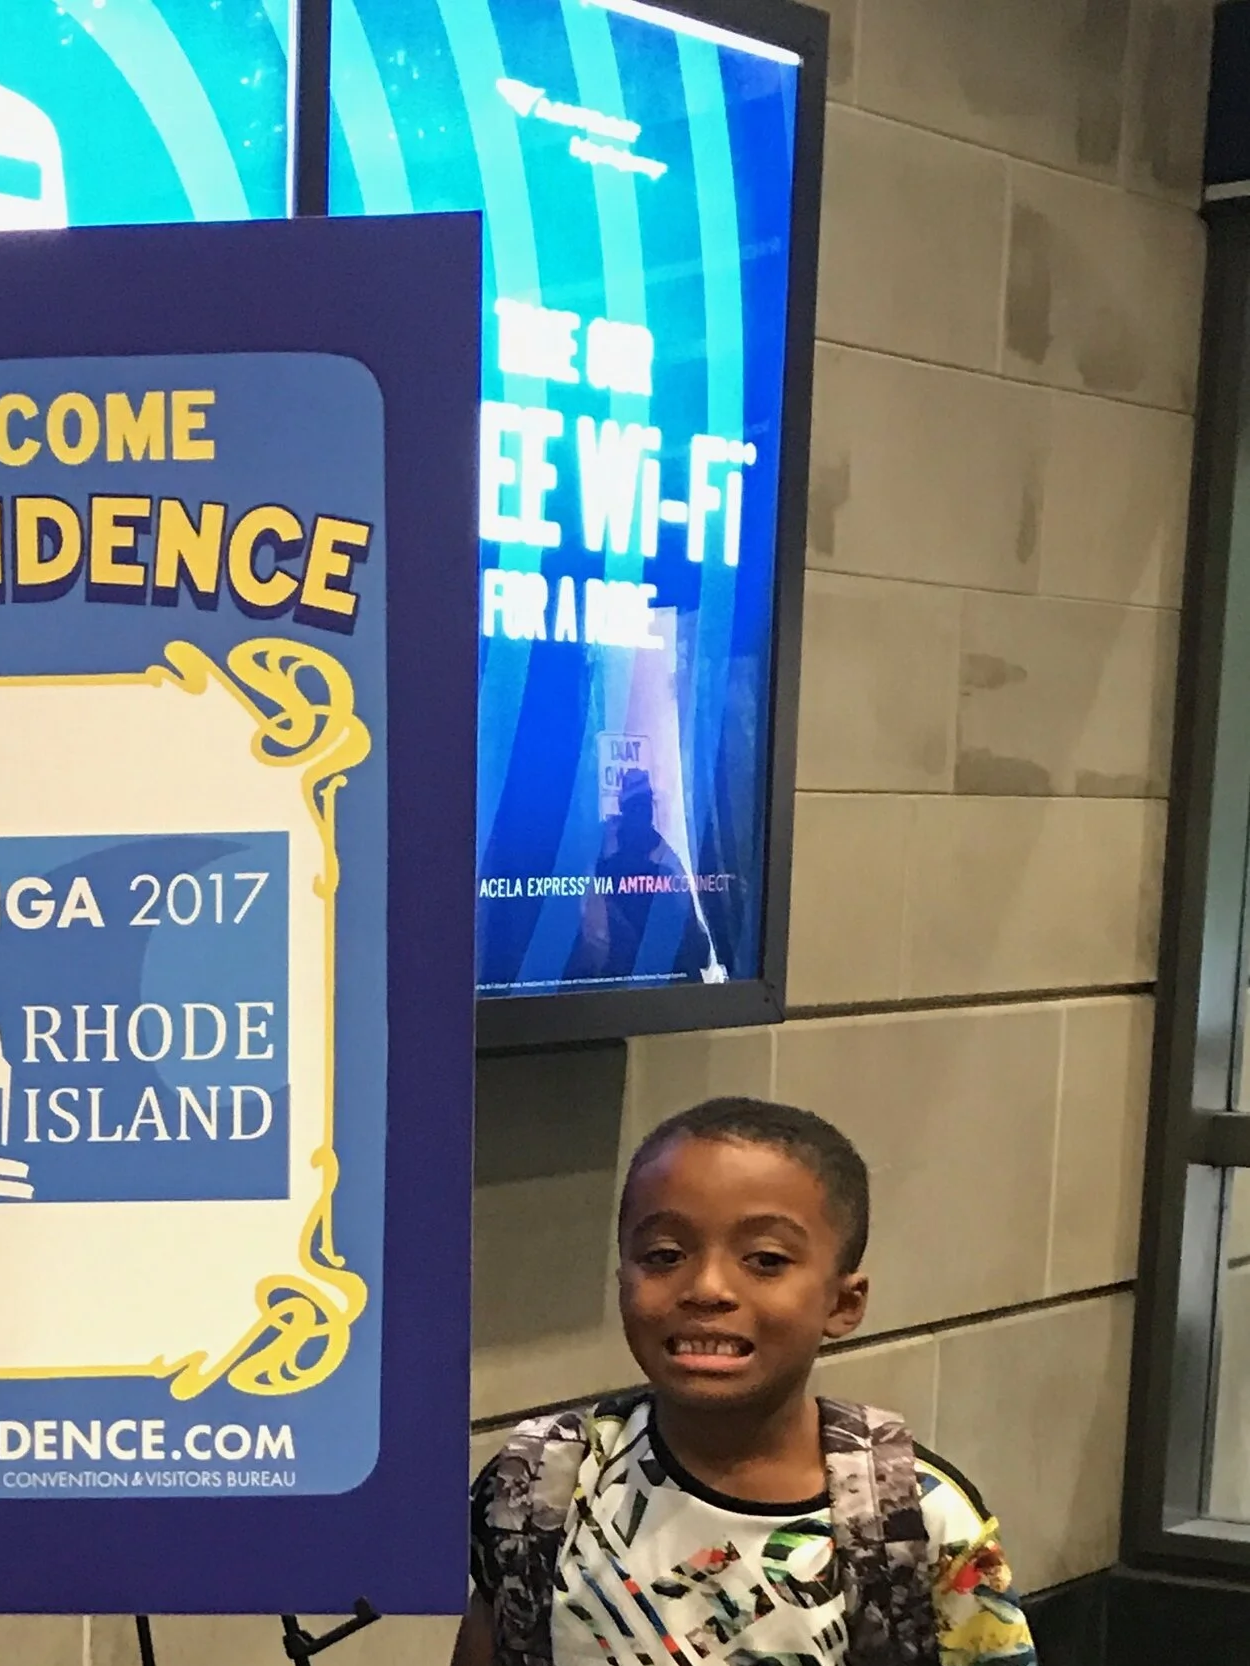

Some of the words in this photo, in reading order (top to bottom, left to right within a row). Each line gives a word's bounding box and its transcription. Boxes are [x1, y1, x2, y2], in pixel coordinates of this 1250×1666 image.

[129, 873, 269, 926] 2017
[479, 877, 523, 898] ACELA
[594, 875, 614, 895] VIA
[22, 1001, 275, 1064] RHODE
[23, 1085, 273, 1143] ISLAND
[2, 1471, 128, 1488] CONVENTION
[145, 1470, 221, 1487] VISITORS
[227, 1470, 296, 1487] BUREAU
